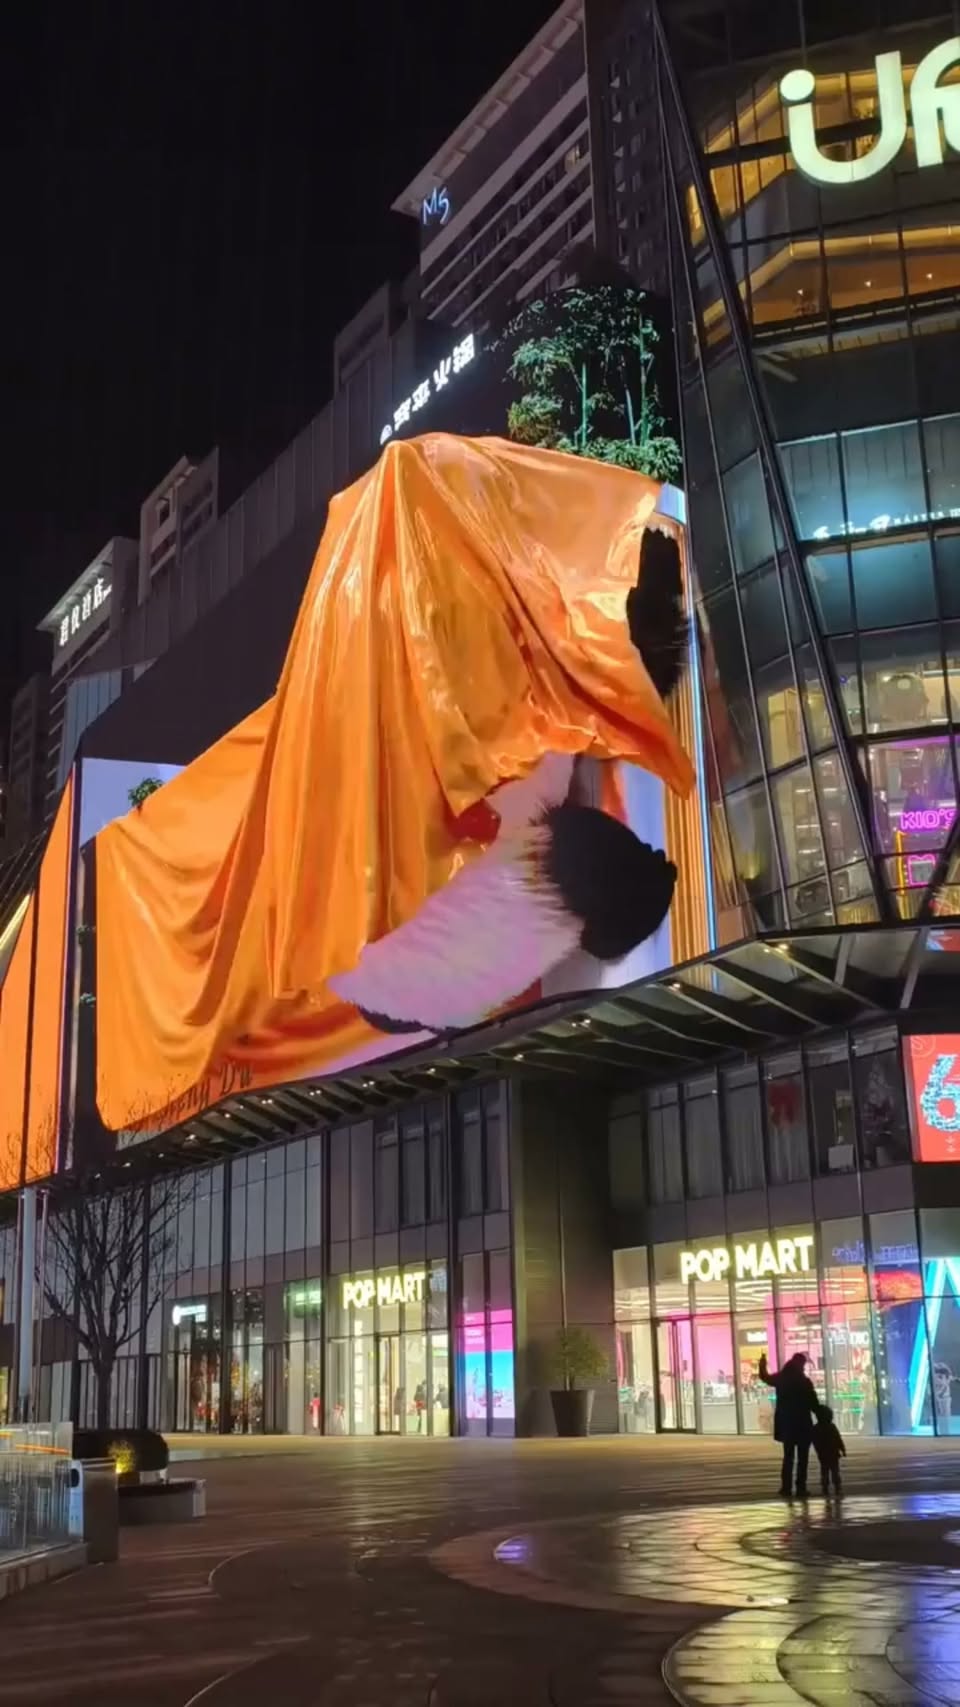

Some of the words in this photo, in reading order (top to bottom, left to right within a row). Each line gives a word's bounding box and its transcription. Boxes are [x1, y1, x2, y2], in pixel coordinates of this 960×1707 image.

[680, 1247, 731, 1285] POP
[734, 1236, 813, 1280] MART
[343, 1280, 375, 1310] POP
[377, 1271, 426, 1306] MART
